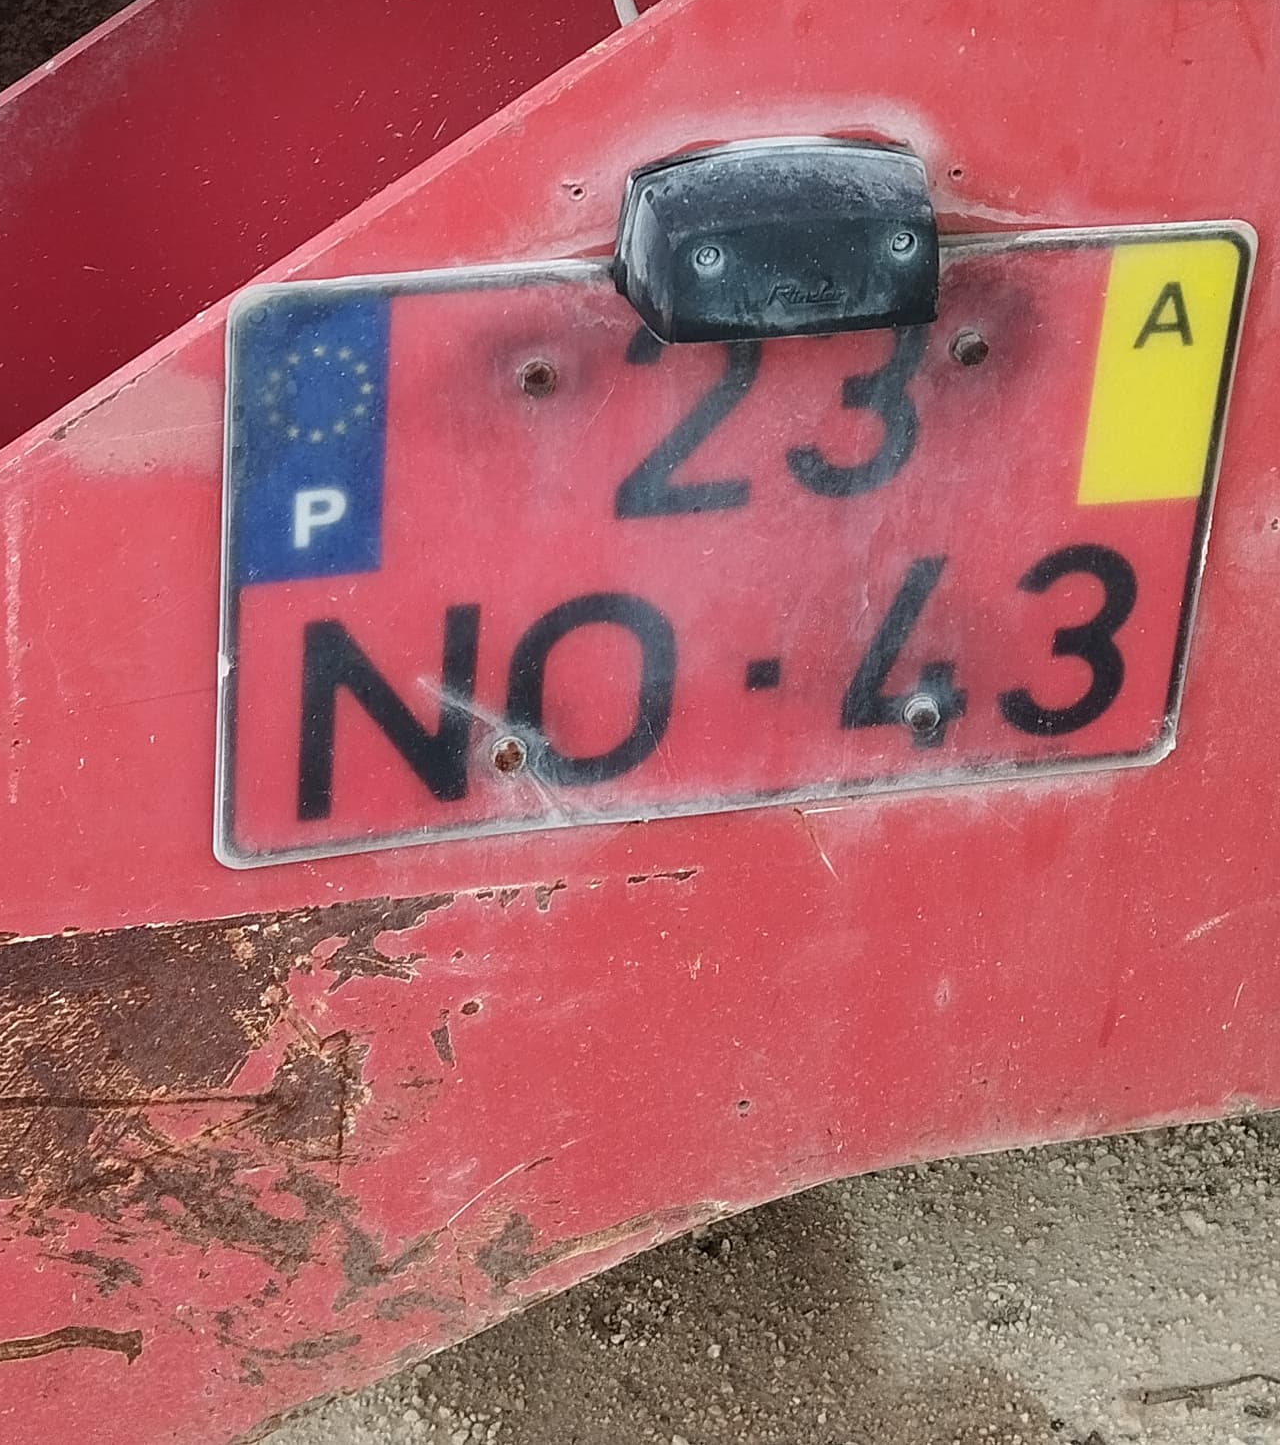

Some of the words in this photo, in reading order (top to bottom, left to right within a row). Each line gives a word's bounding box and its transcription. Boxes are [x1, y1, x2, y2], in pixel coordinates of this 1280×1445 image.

[1132, 281, 1195, 350] A
[614, 326, 920, 520] 23
[293, 487, 347, 550] P
